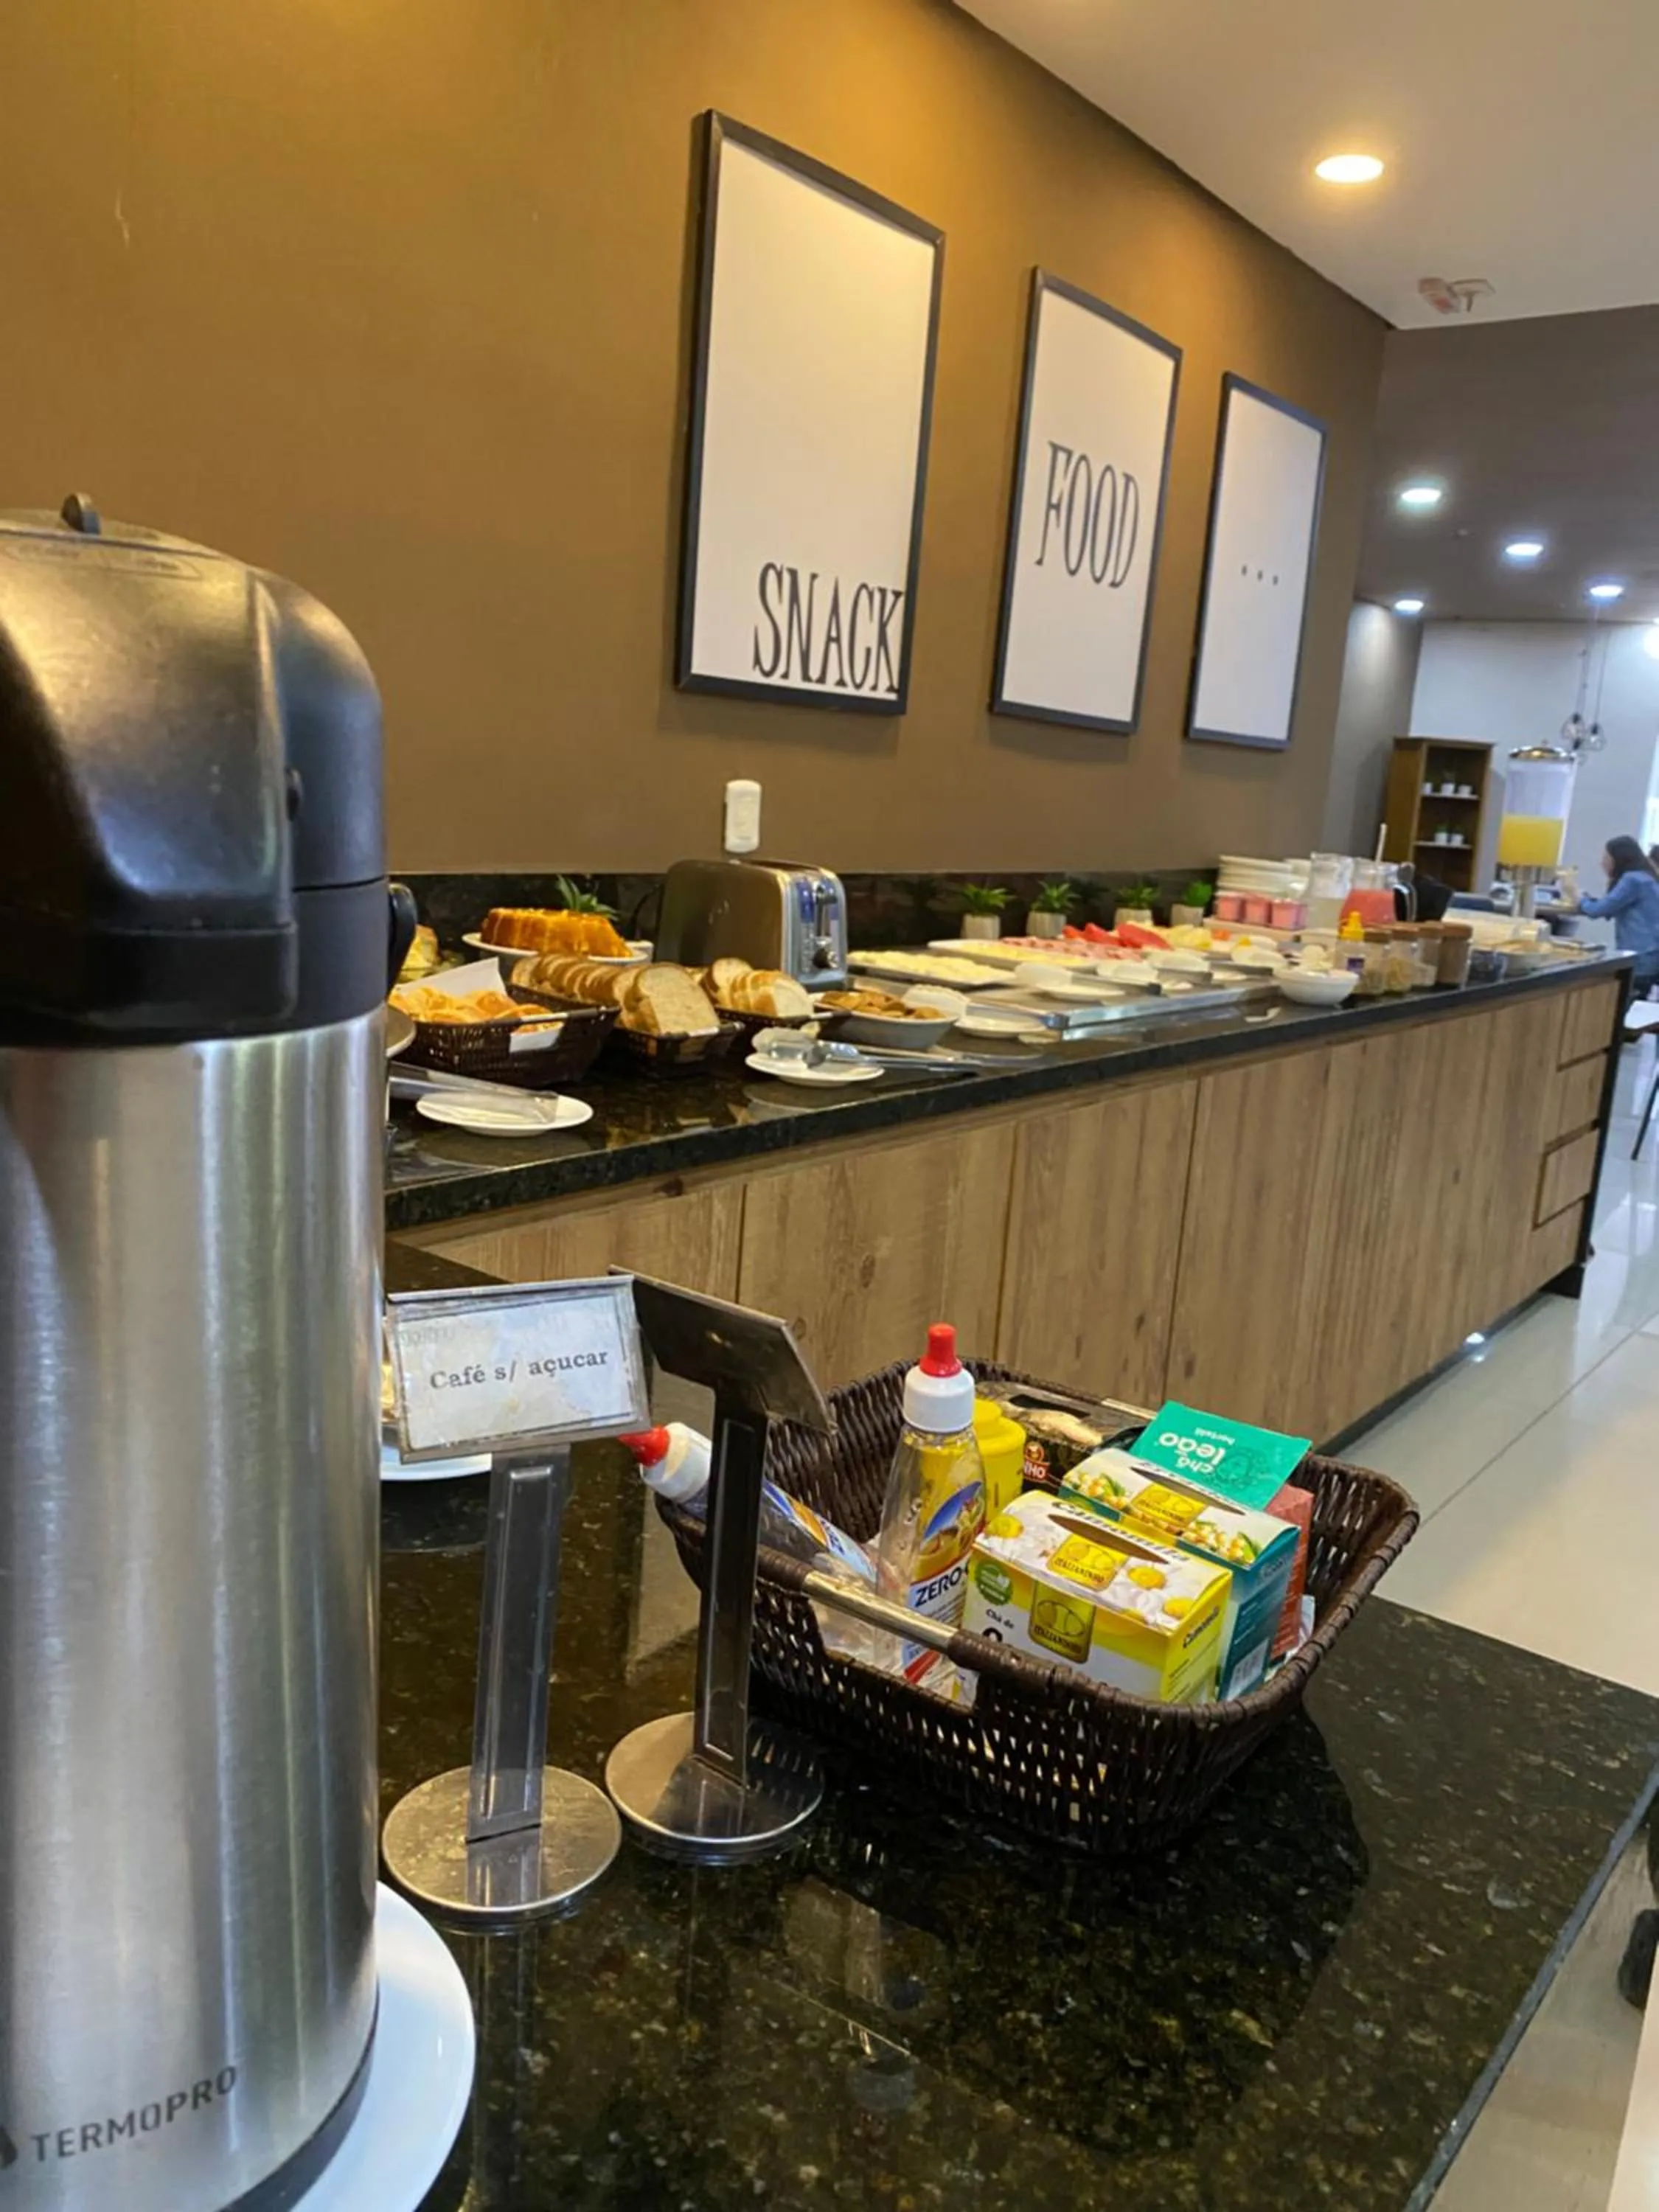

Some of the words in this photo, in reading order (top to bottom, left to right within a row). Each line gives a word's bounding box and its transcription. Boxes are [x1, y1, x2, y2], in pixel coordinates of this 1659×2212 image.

[1034, 439, 1139, 588] FOOD
[753, 561, 904, 693] SNACK
[430, 1364, 486, 1389] Café
[494, 1360, 516, 1383] s/
[528, 1351, 608, 1378] açucar
[29, 2065, 237, 2163] TERMOPRO
